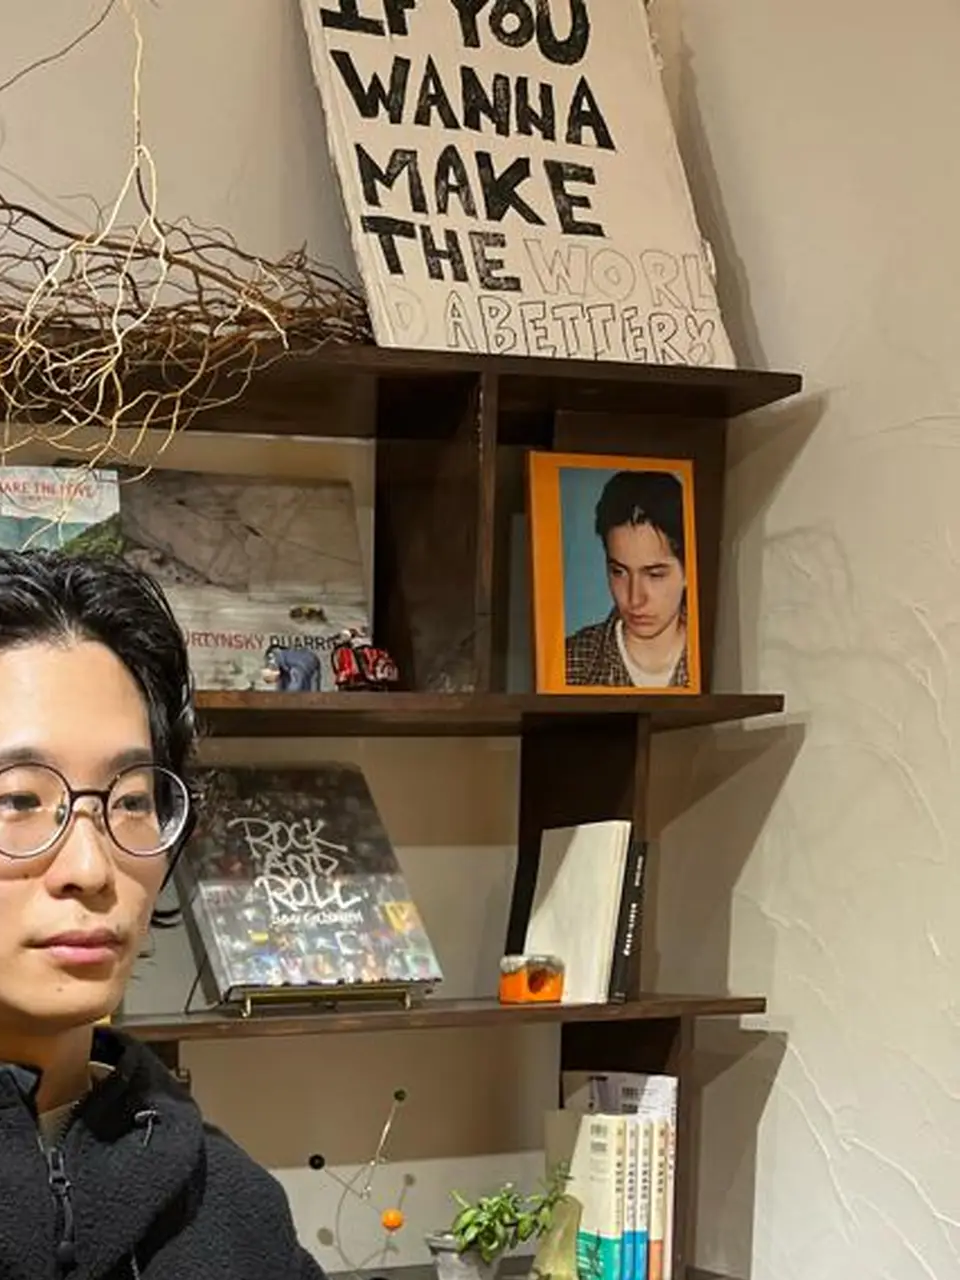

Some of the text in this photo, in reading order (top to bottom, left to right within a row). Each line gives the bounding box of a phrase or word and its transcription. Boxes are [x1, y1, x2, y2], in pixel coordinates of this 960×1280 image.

[456, 0, 590, 65] YOU
[329, 49, 616, 152] WANNA
[354, 143, 606, 238] MAKE
[361, 215, 522, 293] THE
[185, 630, 341, 651] RTYNSKY QUARRI
[227, 816, 349, 860] ROCK
[253, 872, 363, 916] ROLL
[263, 851, 339, 884] AND
